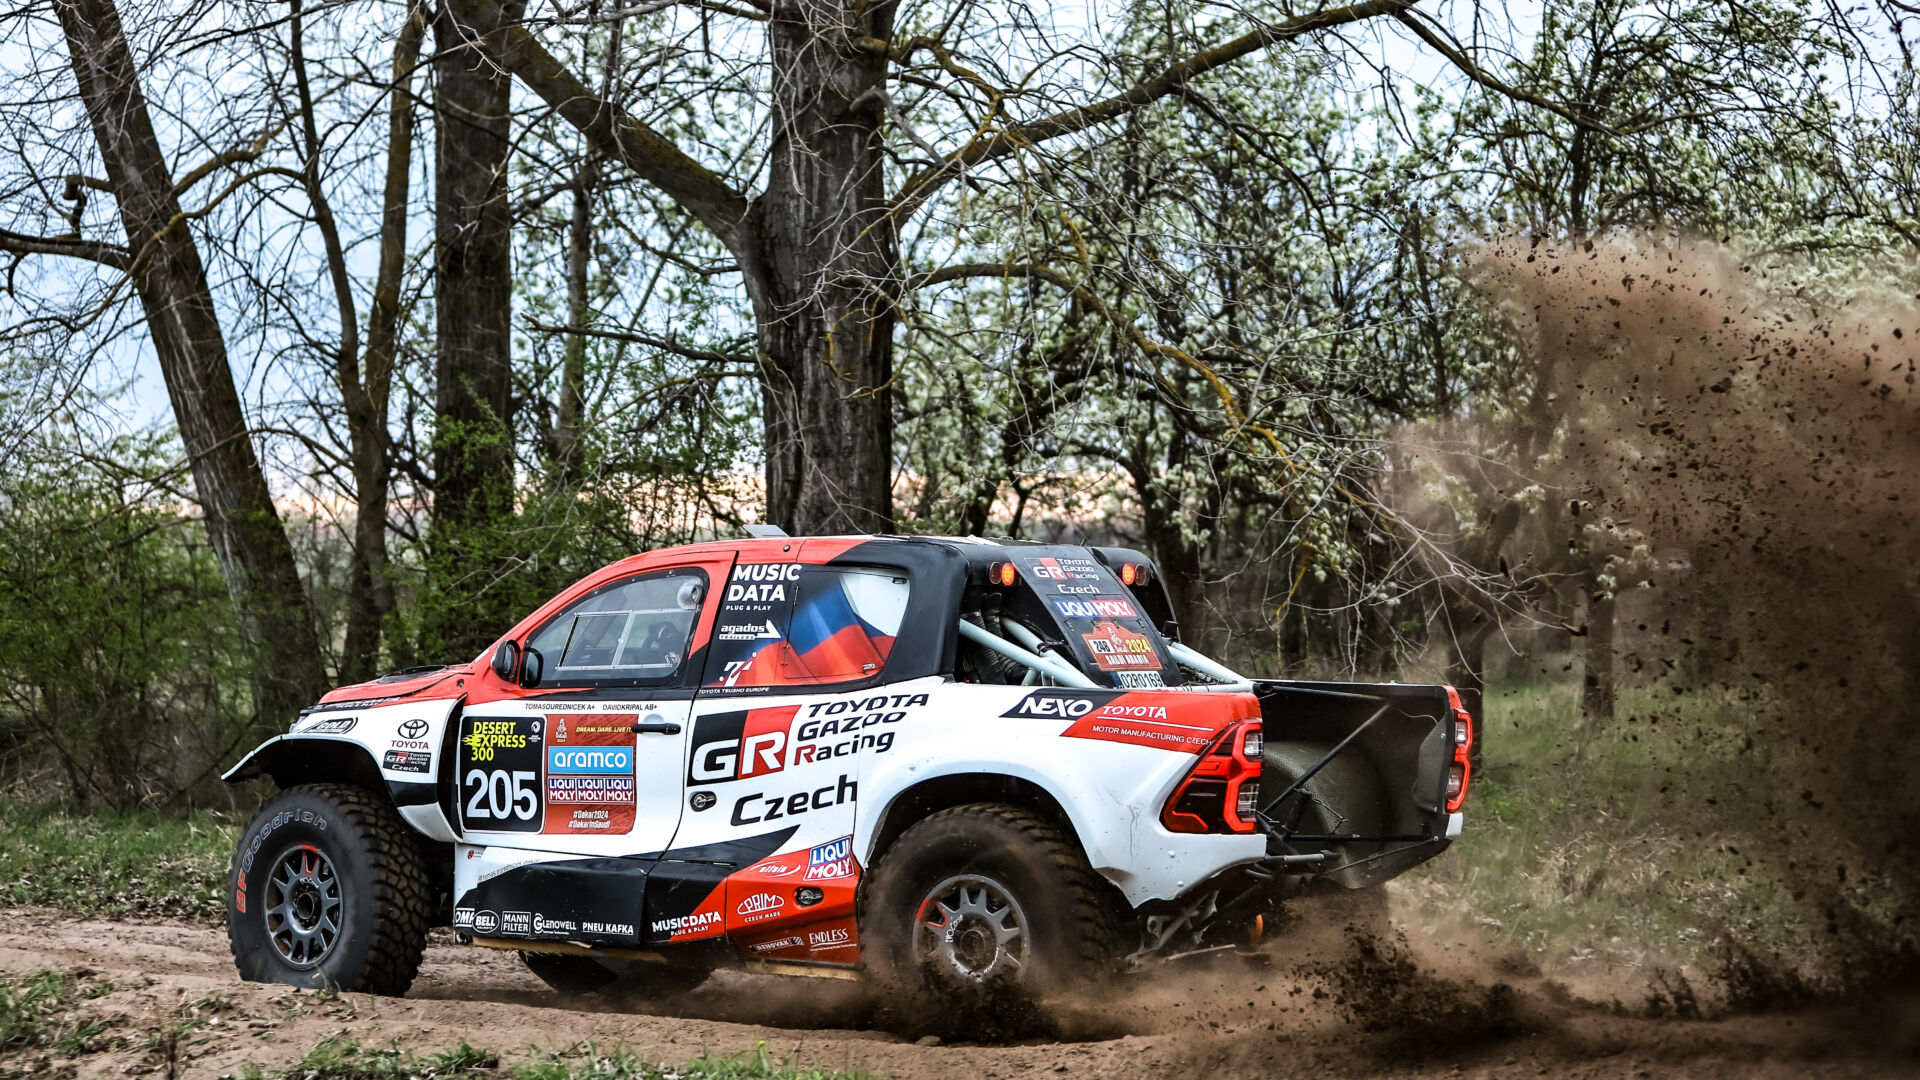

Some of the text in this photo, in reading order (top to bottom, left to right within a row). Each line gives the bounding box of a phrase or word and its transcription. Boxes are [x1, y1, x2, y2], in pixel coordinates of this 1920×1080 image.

[732, 564, 802, 581] MUSIC
[1033, 566, 1064, 578] GR
[1067, 572, 1100, 581] Racing
[727, 584, 786, 602] DATA
[1057, 584, 1101, 594] Czech
[1055, 602, 1132, 616] LIQUI MOLY
[721, 623, 765, 634] agados
[1093, 640, 1111, 653] 248
[1125, 639, 1152, 653] 2024
[808, 693, 930, 718] TOYOTA
[1018, 697, 1094, 717] NEXO
[1102, 706, 1168, 719] TOYOTA
[473, 722, 517, 734] DESERT
[797, 711, 907, 742] GAZOO
[470, 734, 526, 748] EXPRESS
[1092, 725, 1213, 746] MOTOR MANUFACTURING CZECH
[391, 740, 429, 750] TOYOTA
[793, 731, 896, 767] Racing
[386, 755, 407, 764] GR
[471, 747, 494, 761] 300
[554, 752, 627, 768] aramco
[691, 731, 787, 781] GR
[391, 764, 419, 772] Czech
[549, 779, 574, 790] LIQUI
[577, 779, 603, 790] LIQUI
[606, 780, 632, 790] LIQUI
[465, 769, 538, 821] 205
[550, 790, 576, 800] MOLY
[578, 790, 604, 801] MOLY
[606, 791, 633, 801] MOLY
[730, 774, 858, 827] Czech
[811, 837, 850, 864] LIQUI
[807, 858, 851, 879] MOLY
[743, 893, 777, 912] PRIM
[475, 915, 496, 927] BELL
[504, 914, 529, 923] MANN
[652, 911, 722, 933] MUSICDATA
[744, 914, 763, 922] CZECH
[503, 922, 529, 932] FILTER
[582, 922, 634, 934] PNEU KAFKA
[693, 925, 709, 933] PLAY
[809, 928, 849, 945] ENDLESS
